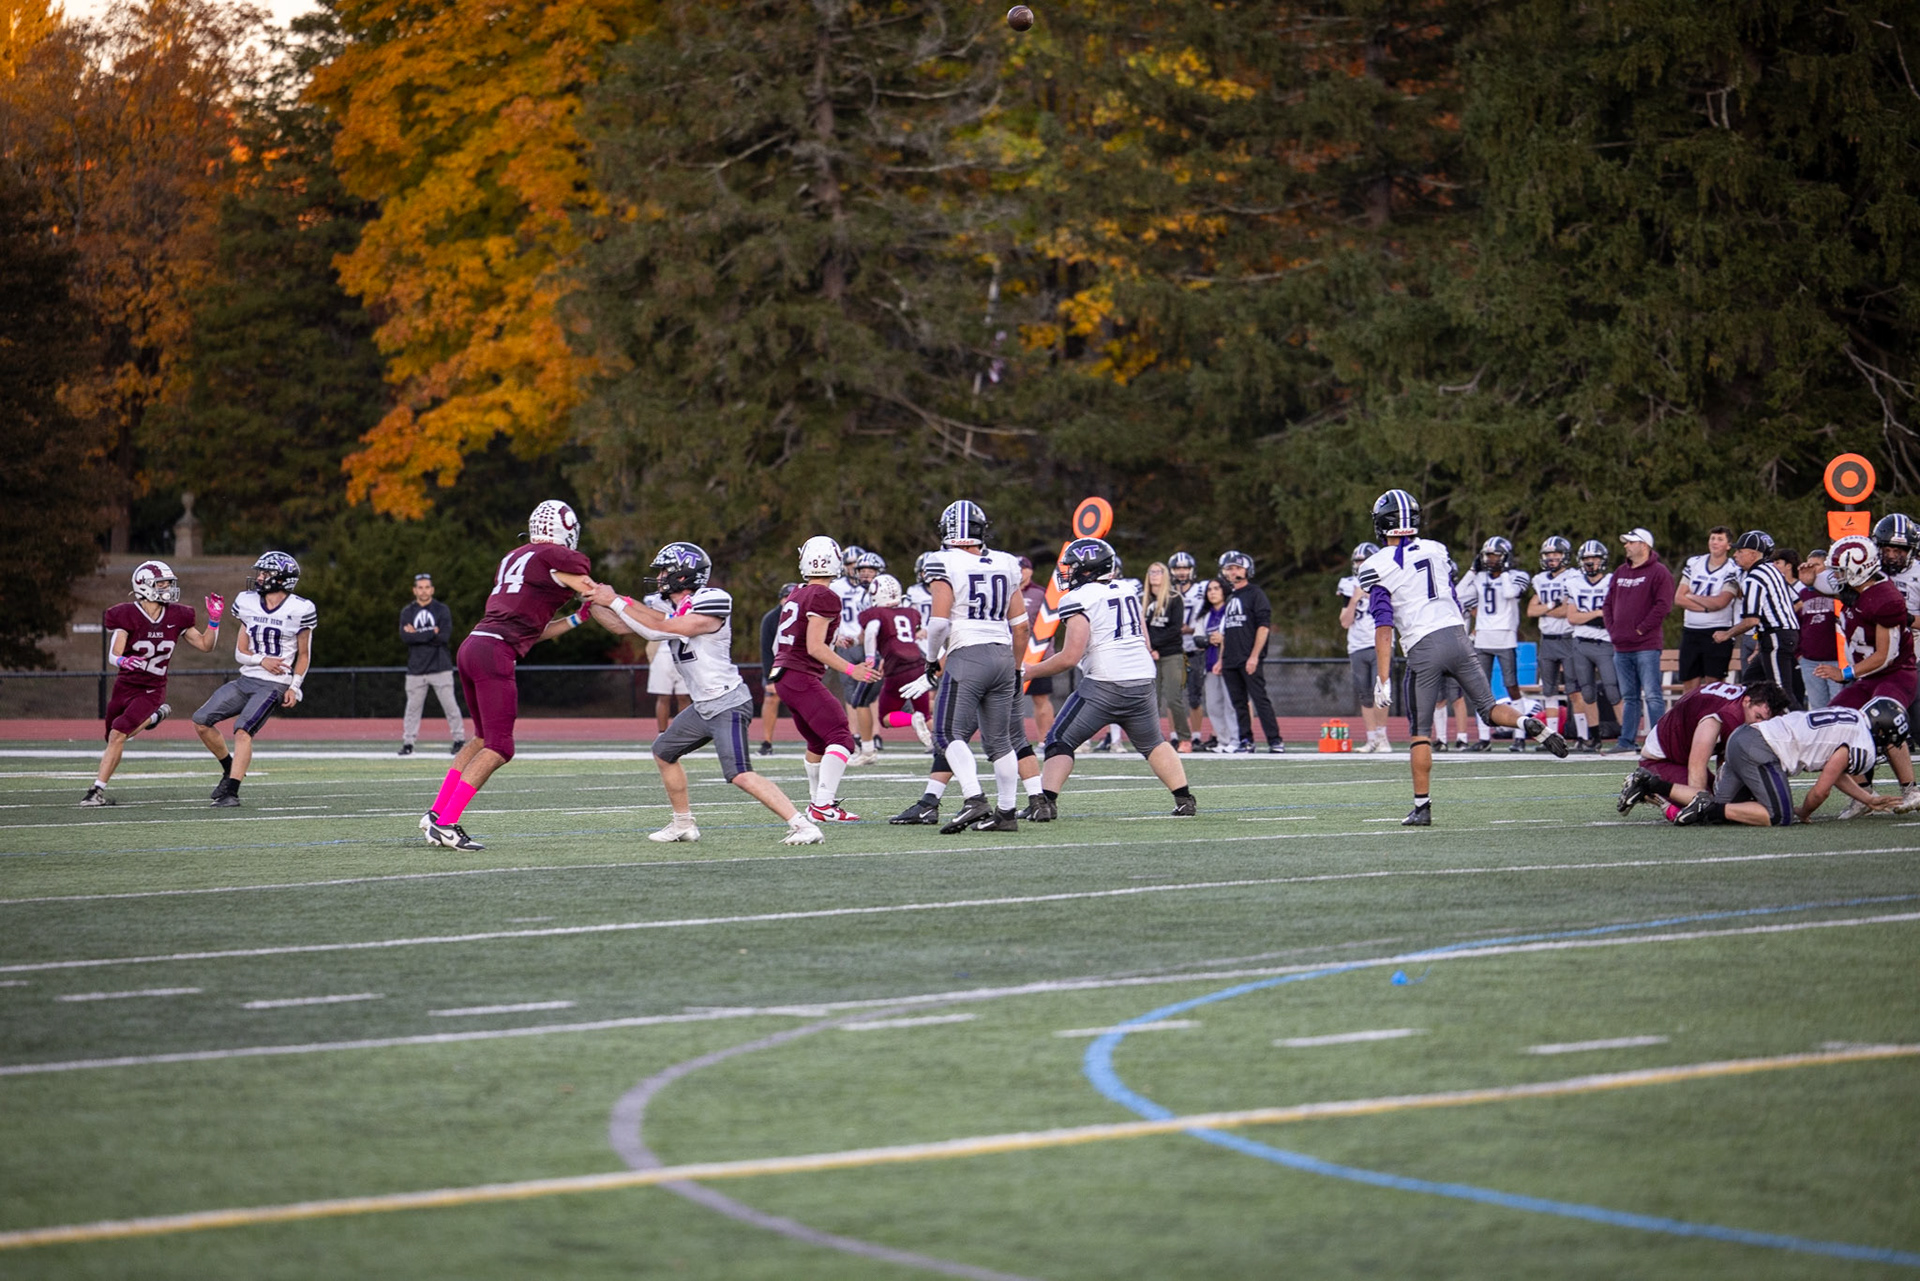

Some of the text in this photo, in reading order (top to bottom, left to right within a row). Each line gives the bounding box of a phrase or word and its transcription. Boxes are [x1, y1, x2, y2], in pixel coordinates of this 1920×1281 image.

[674, 550, 702, 569] VT
[812, 559, 827, 569] 82
[1072, 545, 1100, 561] VT
[491, 551, 535, 595] 14
[1414, 558, 1439, 600] 7
[968, 574, 1008, 621] 50
[1484, 587, 1496, 615] 9
[893, 615, 914, 642] 8
[1107, 595, 1143, 641] 70
[249, 624, 282, 657] 10
[132, 640, 176, 676] 22
[1892, 713, 1910, 735] 68
